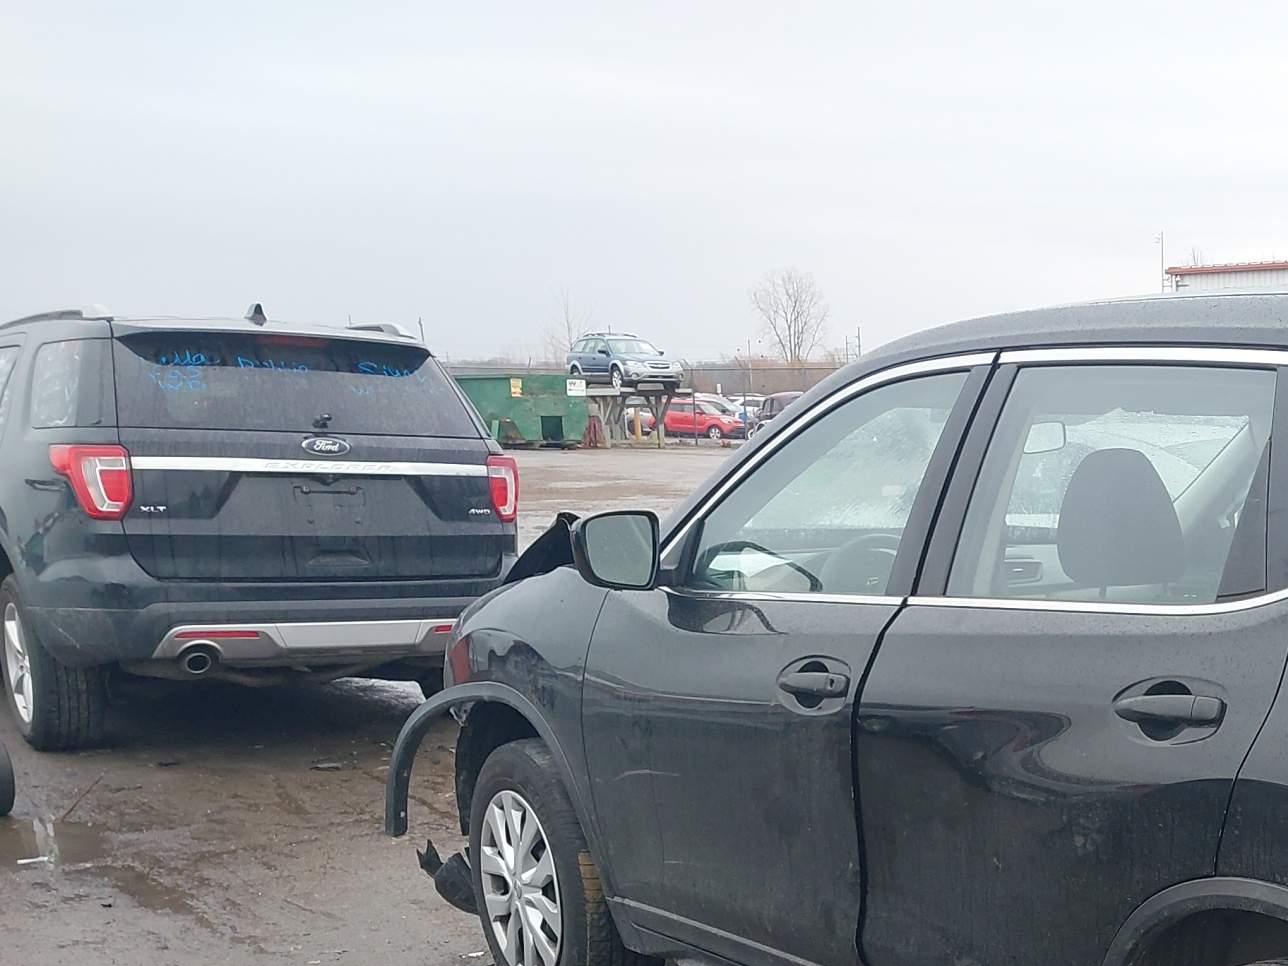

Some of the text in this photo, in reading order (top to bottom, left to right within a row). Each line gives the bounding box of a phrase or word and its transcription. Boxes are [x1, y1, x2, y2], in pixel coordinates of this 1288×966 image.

[312, 440, 341, 453] Ford
[264, 461, 393, 472] EXPLORER
[139, 505, 168, 514] XLT
[467, 508, 492, 516] 4WD
